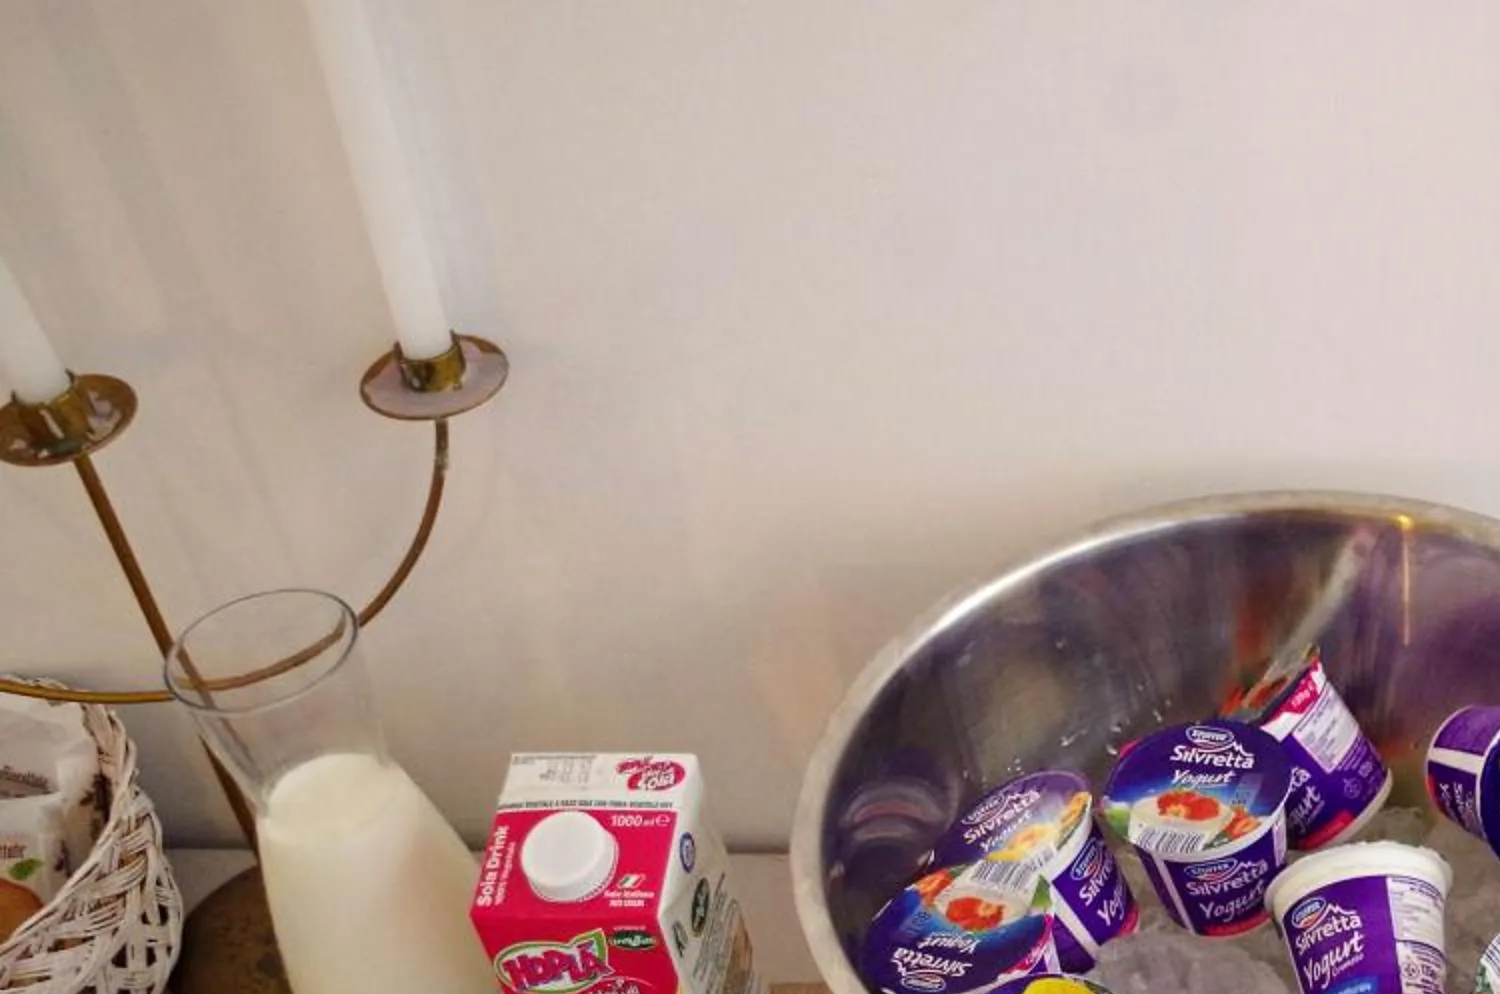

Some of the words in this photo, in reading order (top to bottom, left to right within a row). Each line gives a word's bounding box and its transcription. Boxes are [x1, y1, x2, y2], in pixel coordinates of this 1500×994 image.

[1170, 744, 1255, 769] Silvretta
[1171, 769, 1236, 788] Yogurt
[963, 789, 1041, 844] Silvretta
[487, 824, 510, 868] Drink
[477, 868, 498, 907] Soia
[1186, 858, 1269, 896] Silvretta
[1199, 878, 1265, 922] Yogurt
[918, 931, 982, 954] Yogurt
[1295, 913, 1363, 955] Silvretta
[891, 947, 973, 978] Silvretta
[1303, 931, 1365, 990] Yogurt
